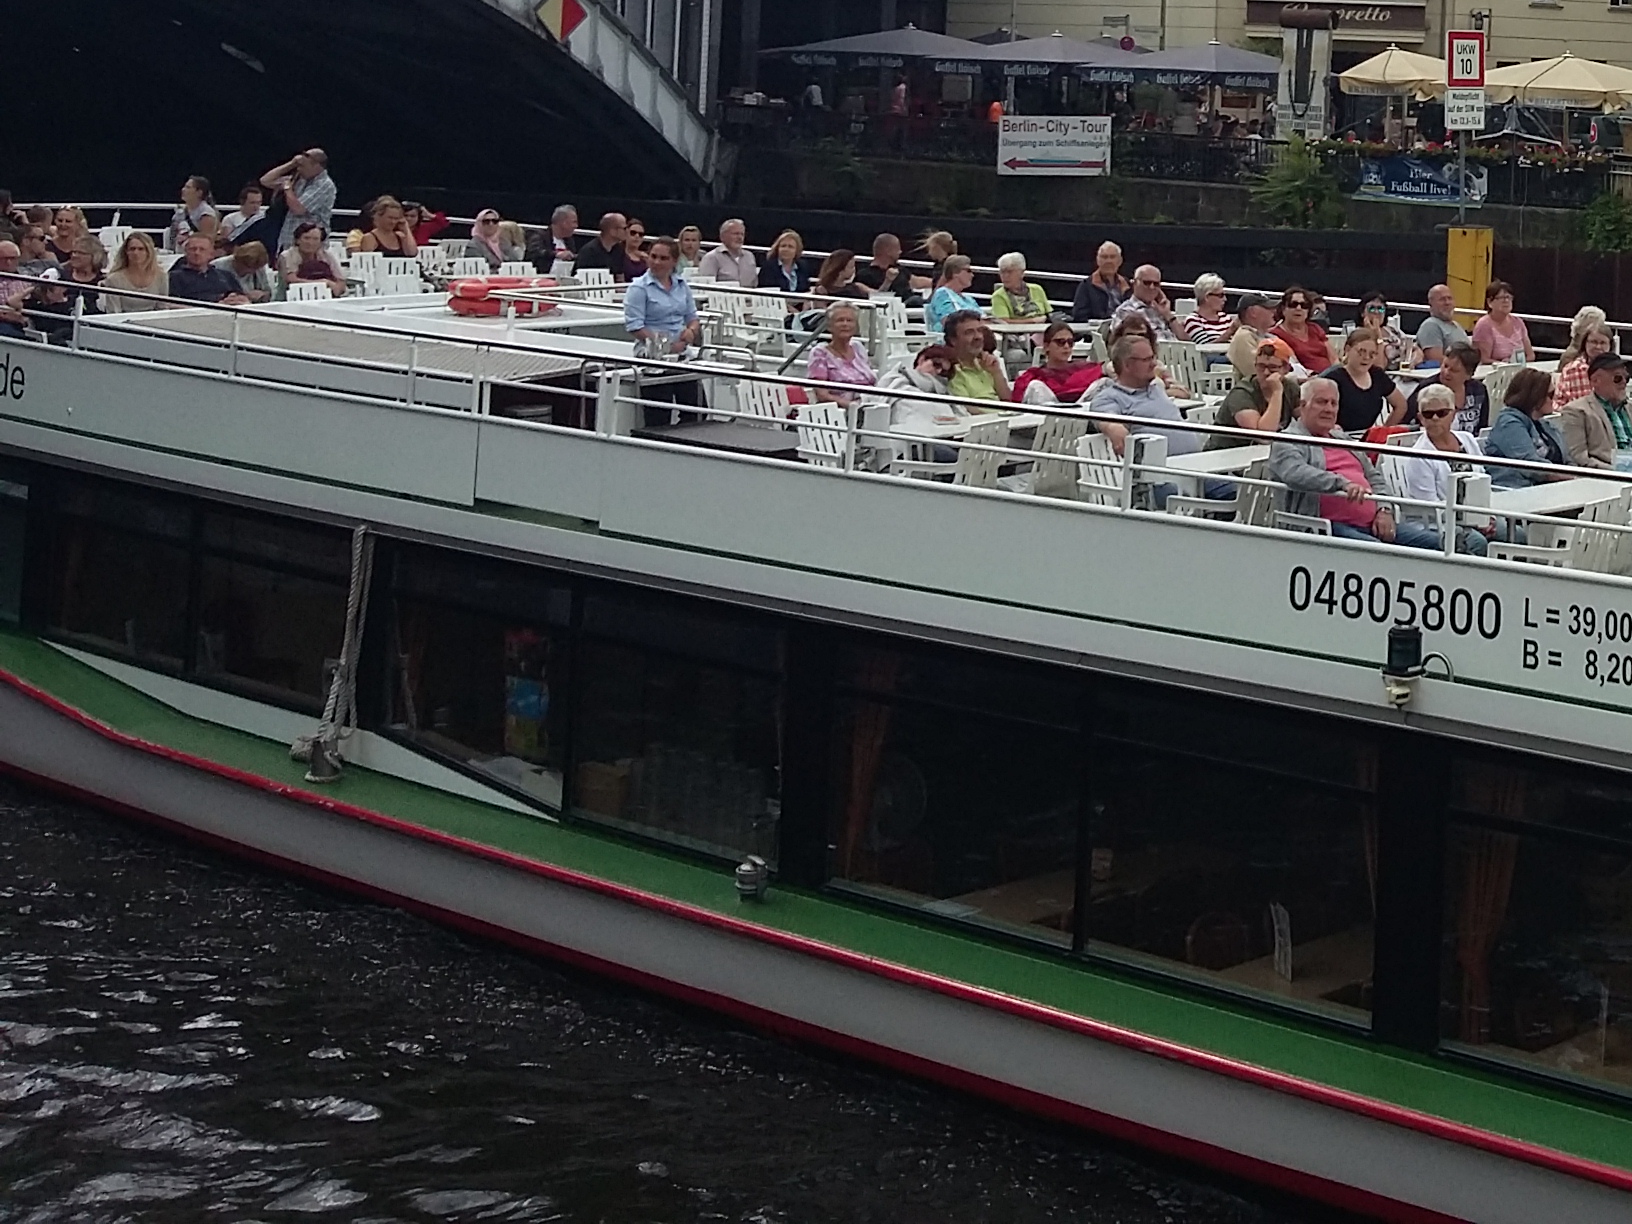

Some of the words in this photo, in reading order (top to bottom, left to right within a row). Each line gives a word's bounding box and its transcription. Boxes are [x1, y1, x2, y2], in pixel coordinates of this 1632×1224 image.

[1456, 44, 1476, 55] UKW
[1461, 58, 1472, 75] 10
[1002, 119, 1108, 136] Berlin-City-Tour
[1002, 139, 1037, 149] Übergang
[1409, 168, 1433, 179] Hier
[1391, 180, 1427, 194] Fußball
[1429, 183, 1452, 195] live!
[1289, 566, 1502, 639] 04805800
[1523, 597, 1538, 628] L
[1568, 604, 1632, 644] 39,00
[1522, 639, 1539, 670] B
